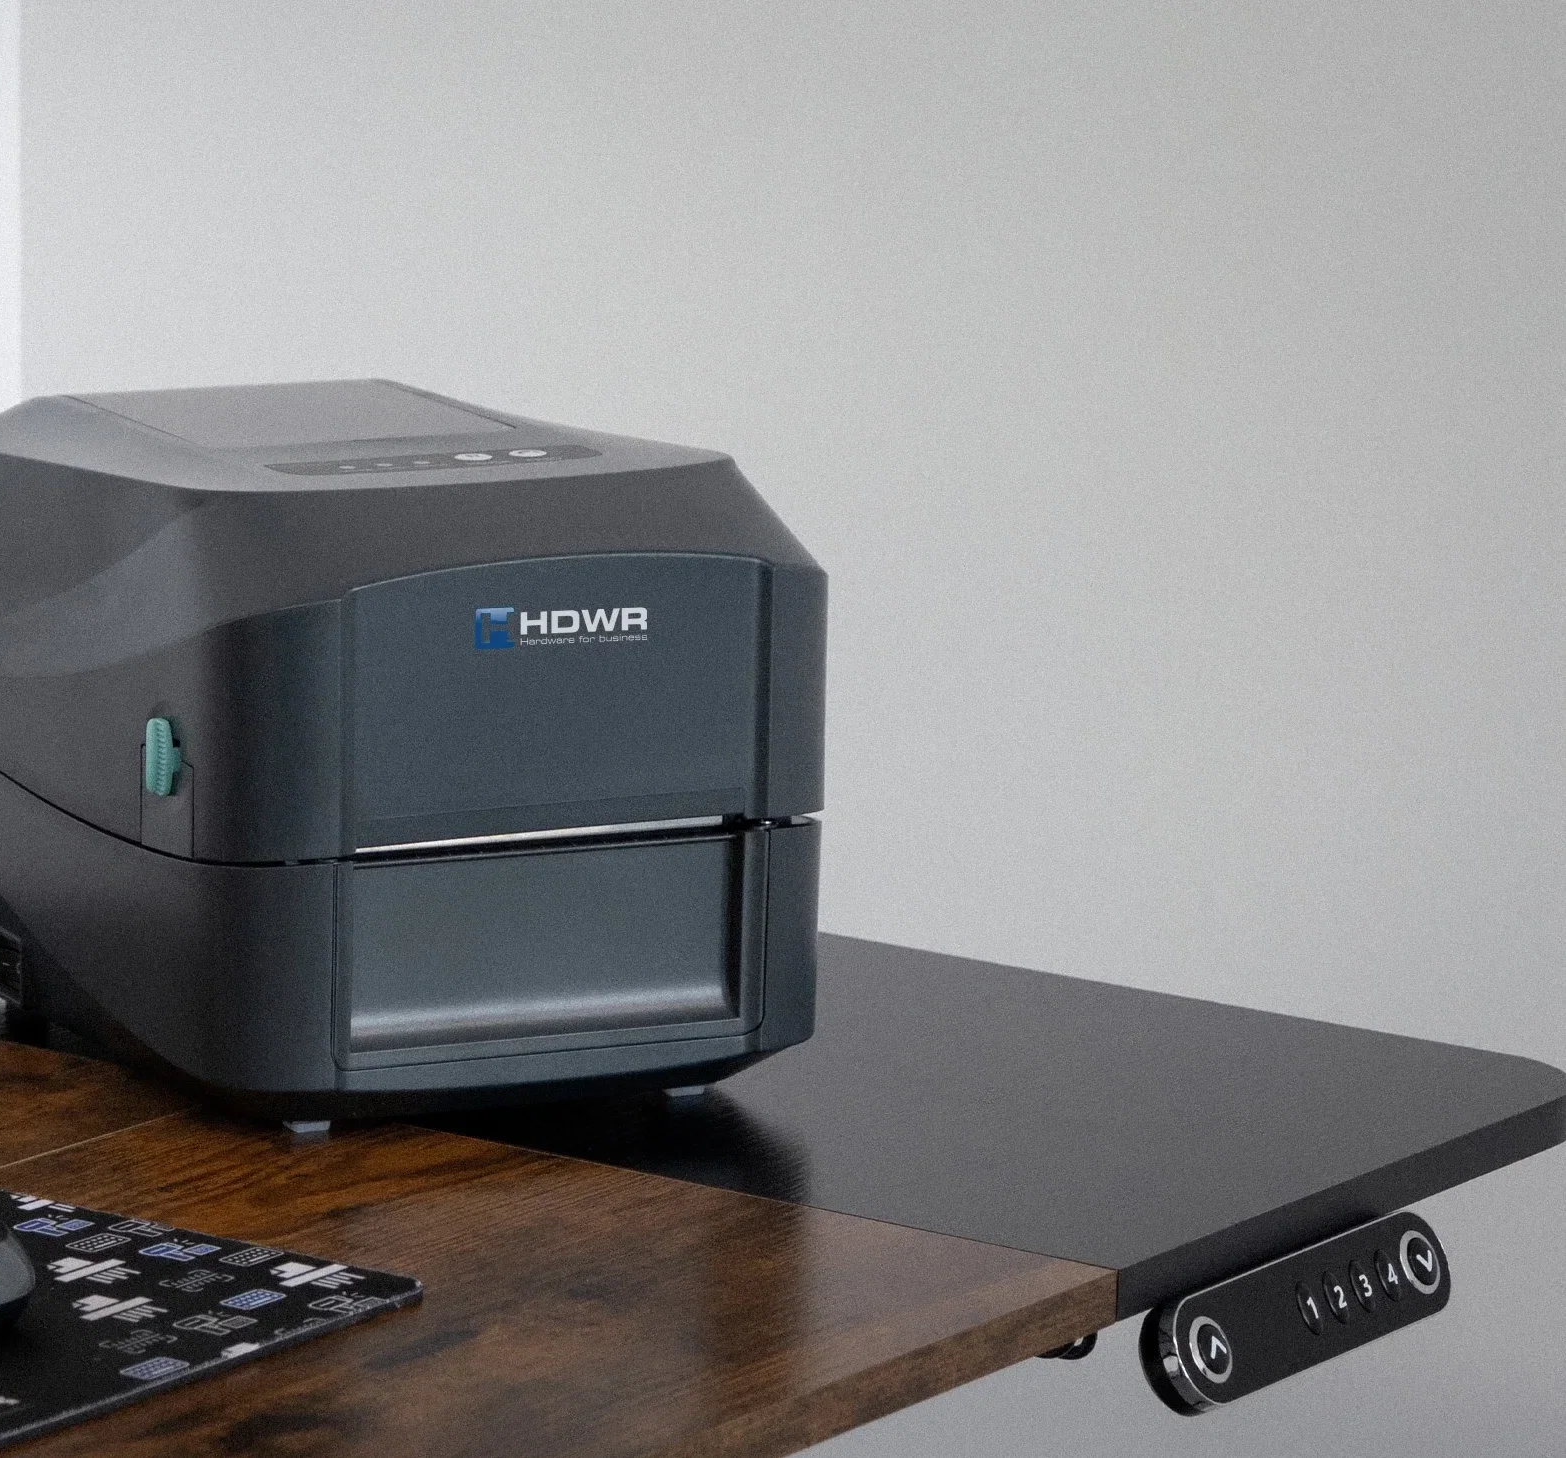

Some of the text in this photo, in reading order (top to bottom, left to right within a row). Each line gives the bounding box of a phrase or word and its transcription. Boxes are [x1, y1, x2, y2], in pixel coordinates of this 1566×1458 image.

[520, 607, 648, 635] HDWR
[520, 633, 648, 646] Hardware for business
[1306, 1263, 1399, 1319] 1 2 3 4
